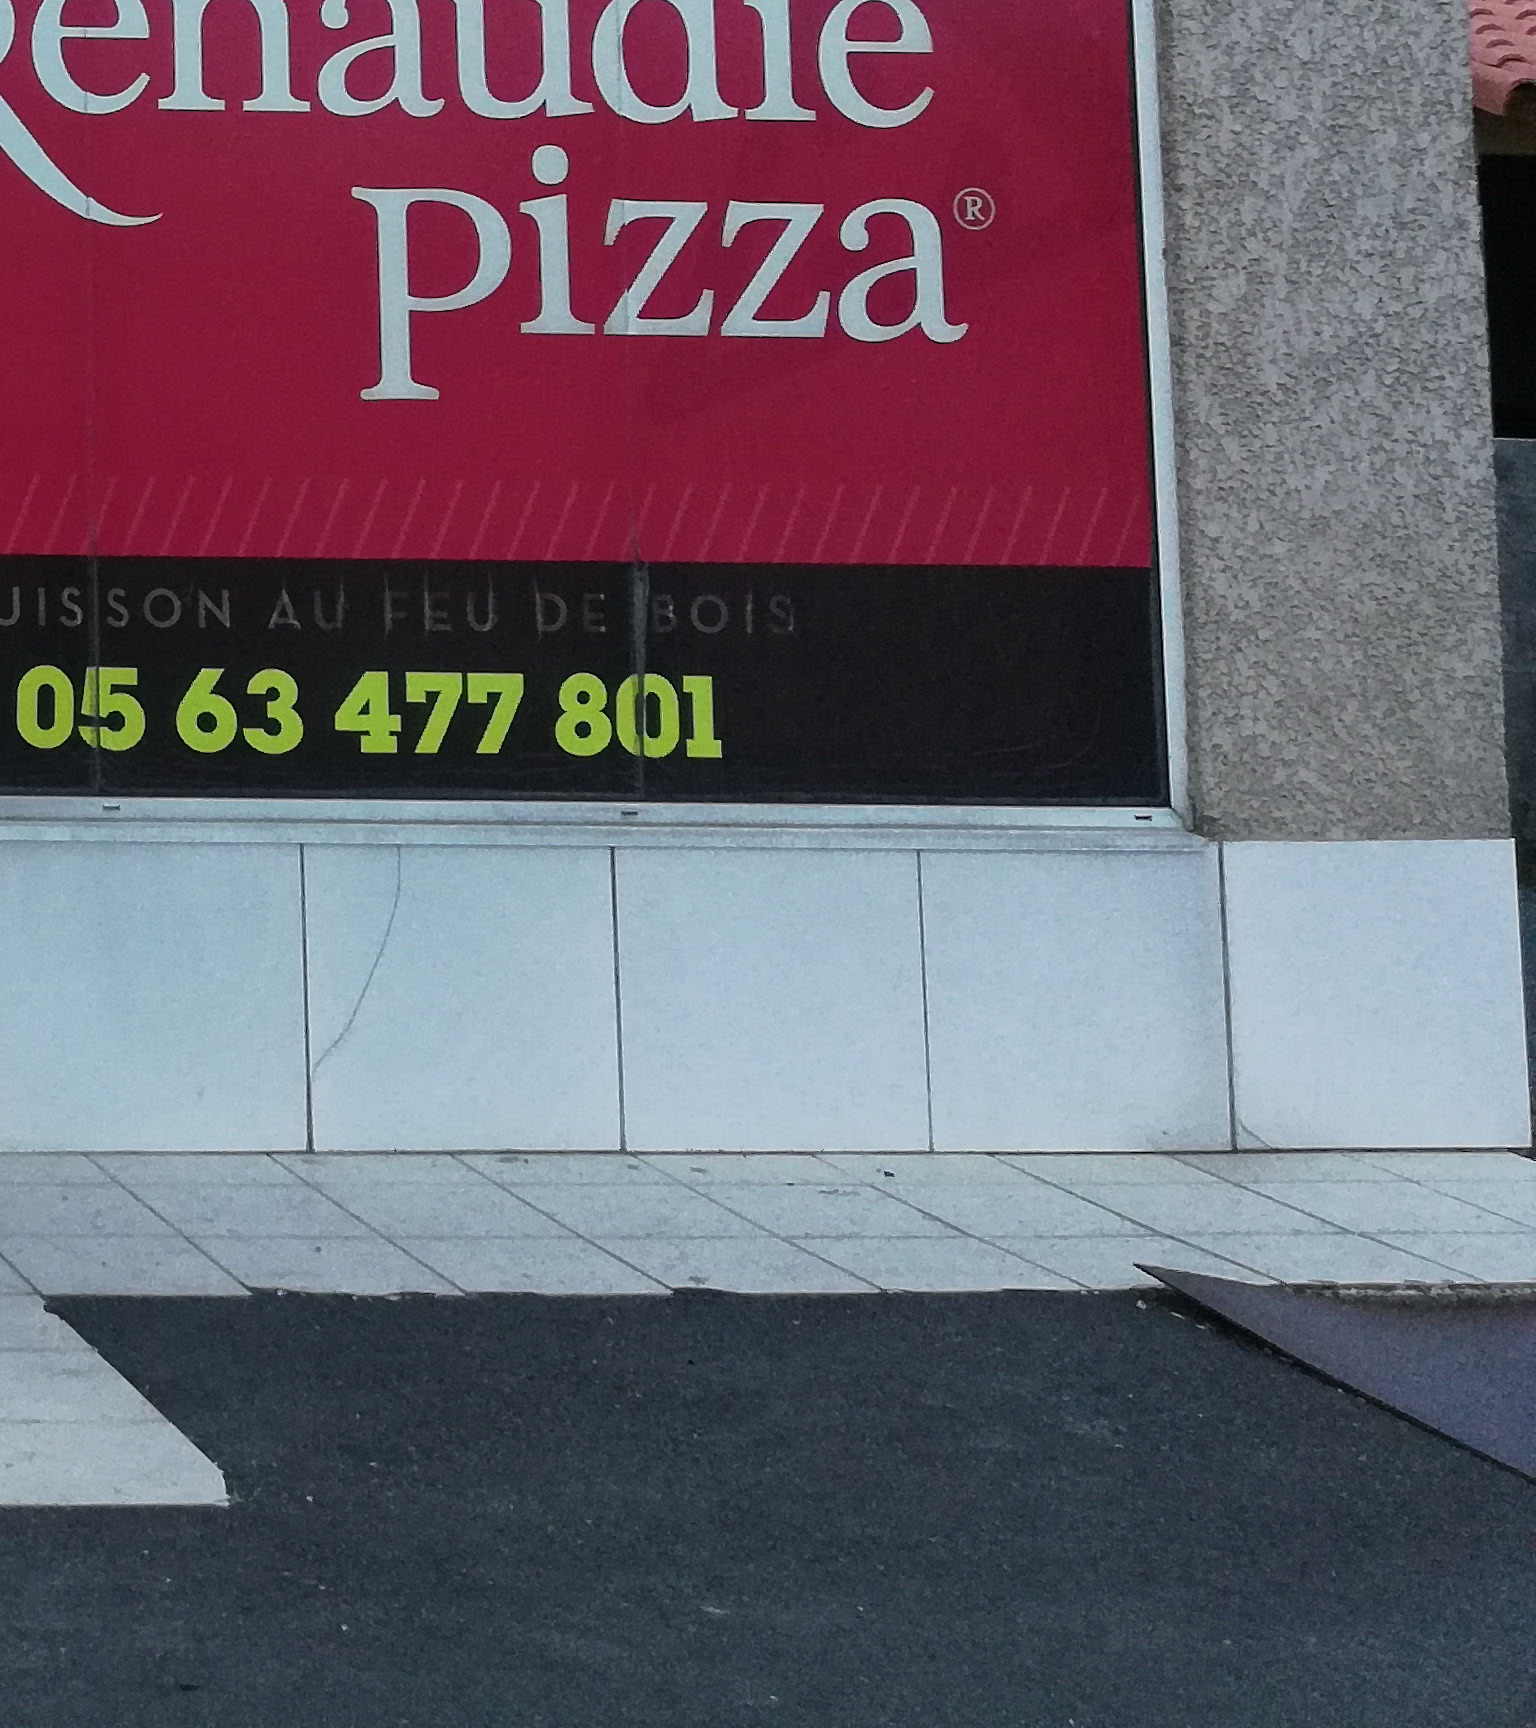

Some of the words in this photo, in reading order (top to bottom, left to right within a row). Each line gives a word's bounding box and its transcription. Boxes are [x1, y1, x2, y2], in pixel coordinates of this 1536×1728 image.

[268, 586, 346, 633] AU
[383, 588, 497, 634] FEU
[534, 590, 608, 635] DE
[651, 592, 795, 636] BOIS
[16, 665, 146, 752] 05
[175, 669, 304, 755] 63
[334, 671, 525, 755] 477
[554, 673, 722, 759] 801
